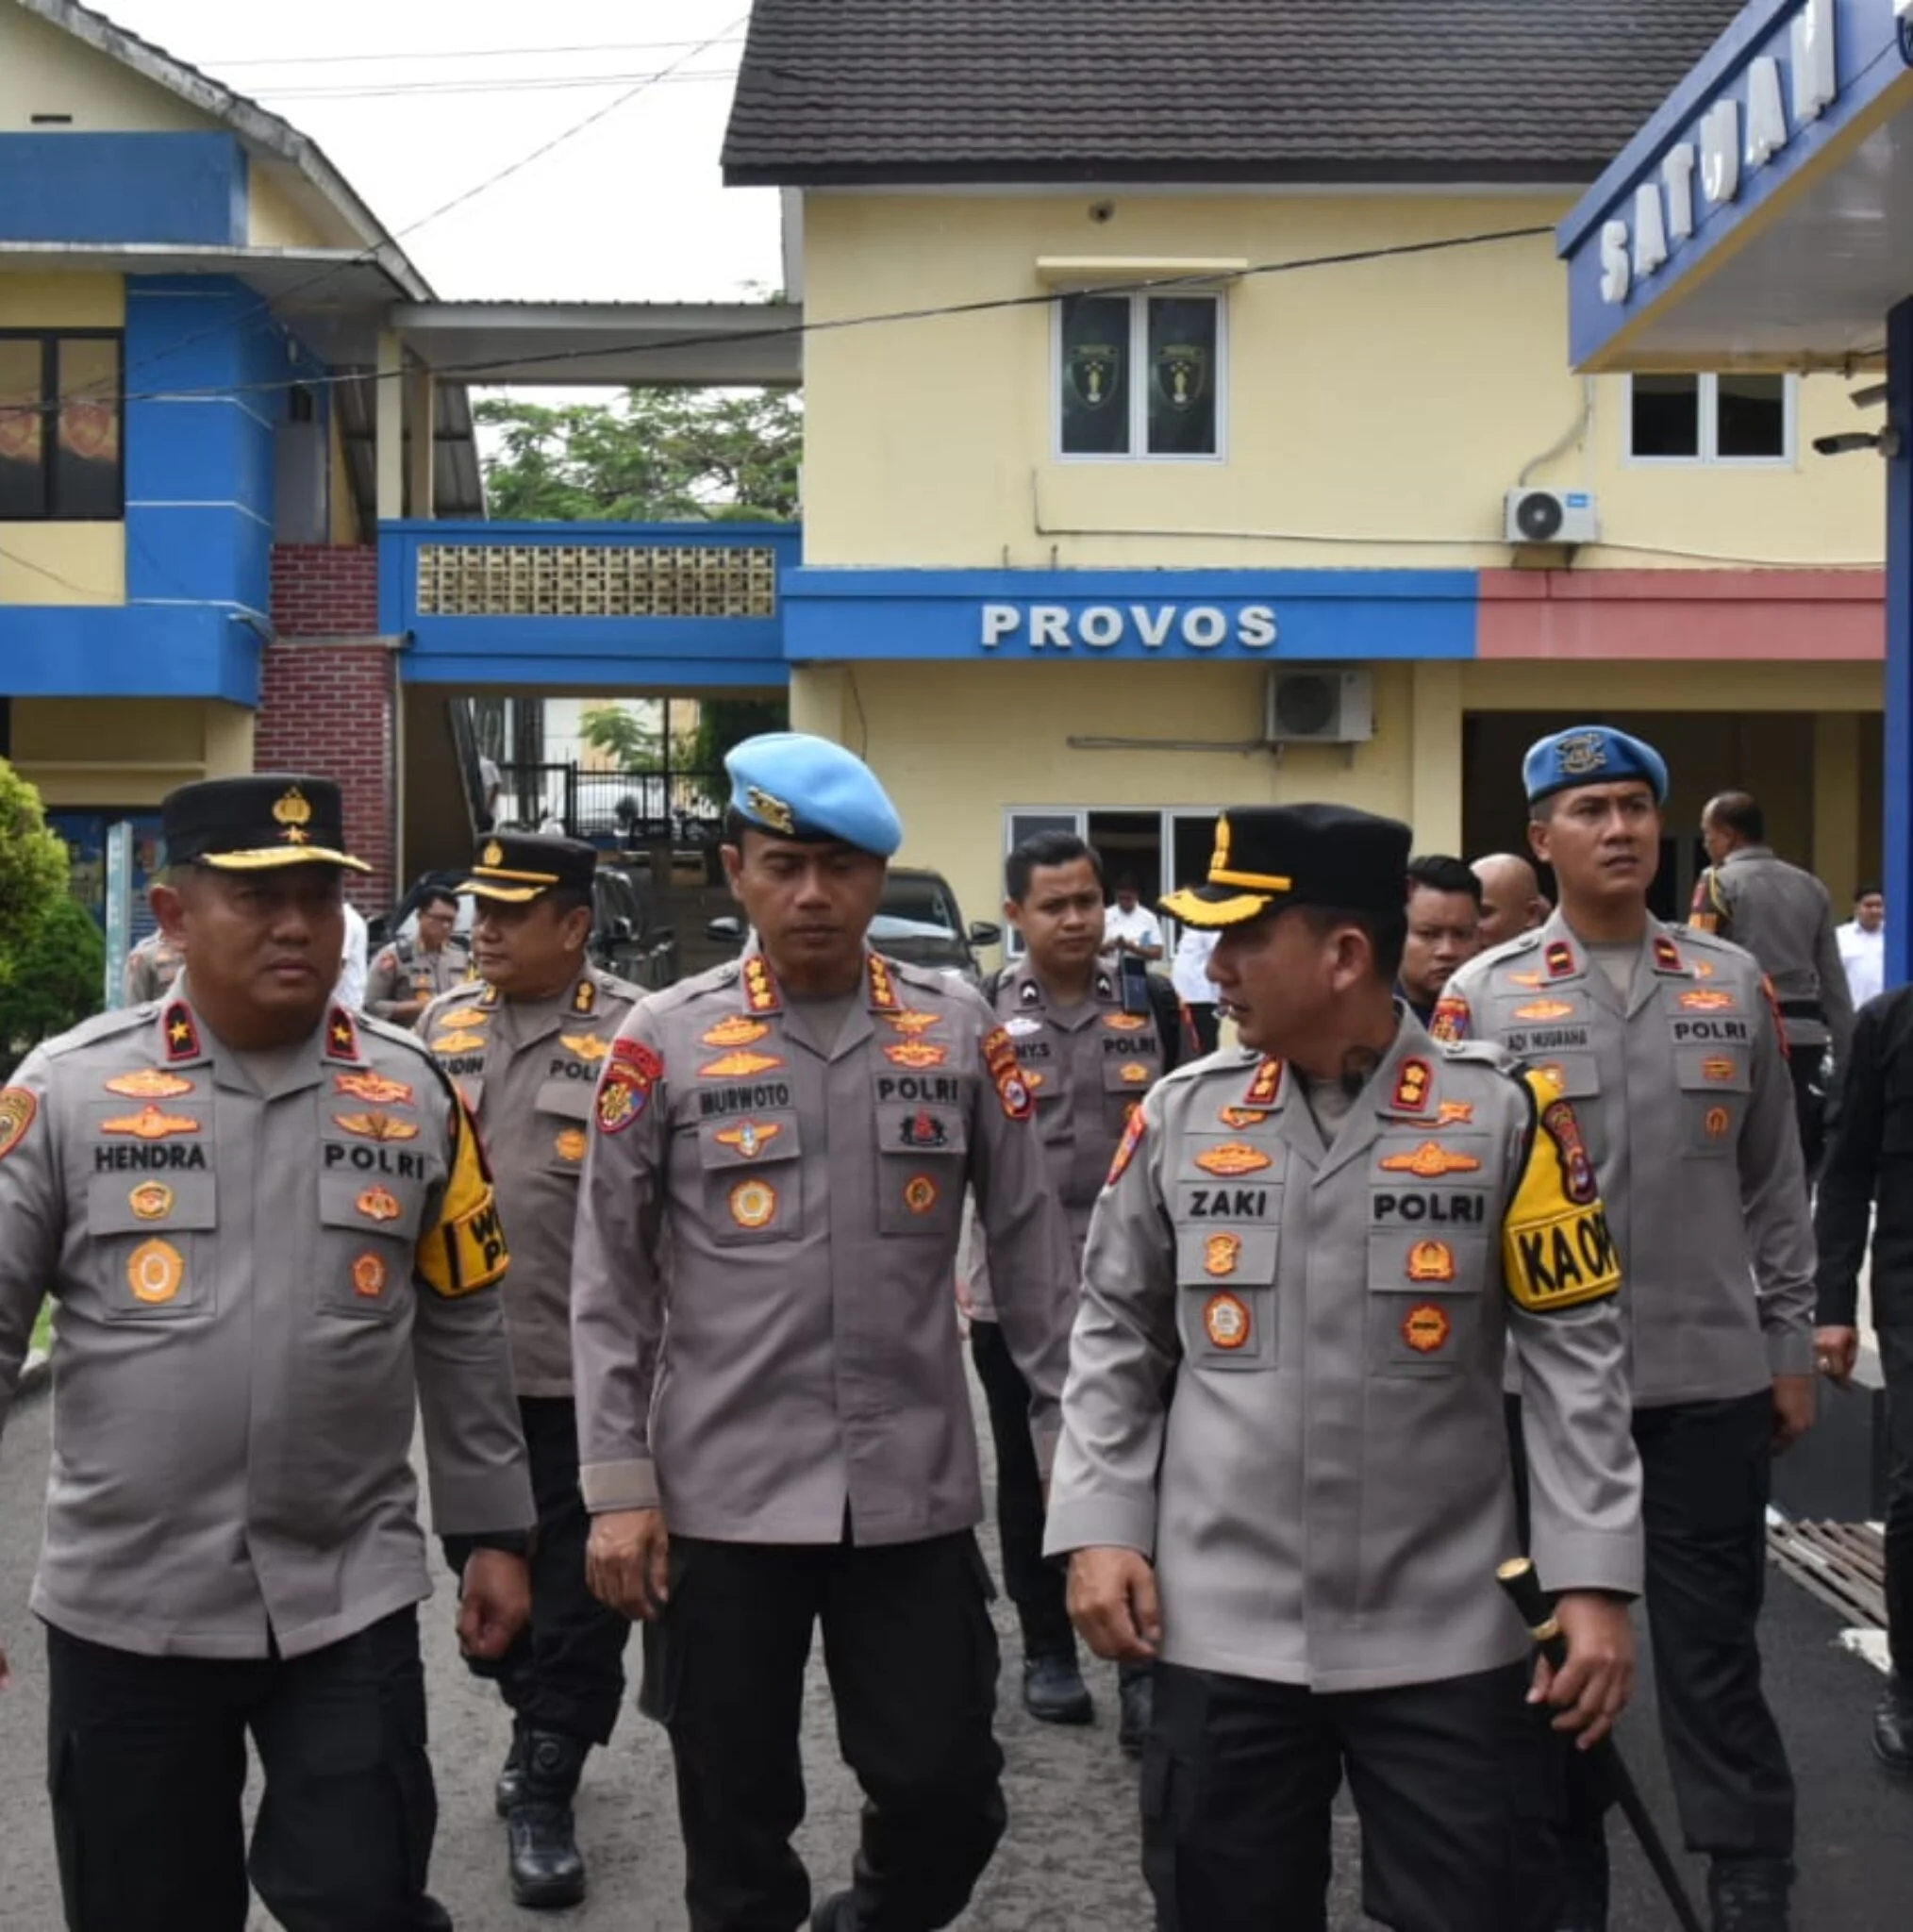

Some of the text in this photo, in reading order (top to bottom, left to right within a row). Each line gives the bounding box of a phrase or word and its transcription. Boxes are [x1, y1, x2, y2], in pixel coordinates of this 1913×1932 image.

[981, 604, 1278, 648] PROVOS
[1673, 1021, 1746, 1041] POLRI
[1102, 1038, 1156, 1055] POLRI
[878, 1076, 958, 1102] POLRI
[94, 1142, 207, 1171] HENDRA
[324, 1143, 424, 1180] POLRI
[1189, 1190, 1267, 1218] ZAKI
[1372, 1192, 1485, 1223] POLRI
[1518, 1225, 1583, 1296] KA
